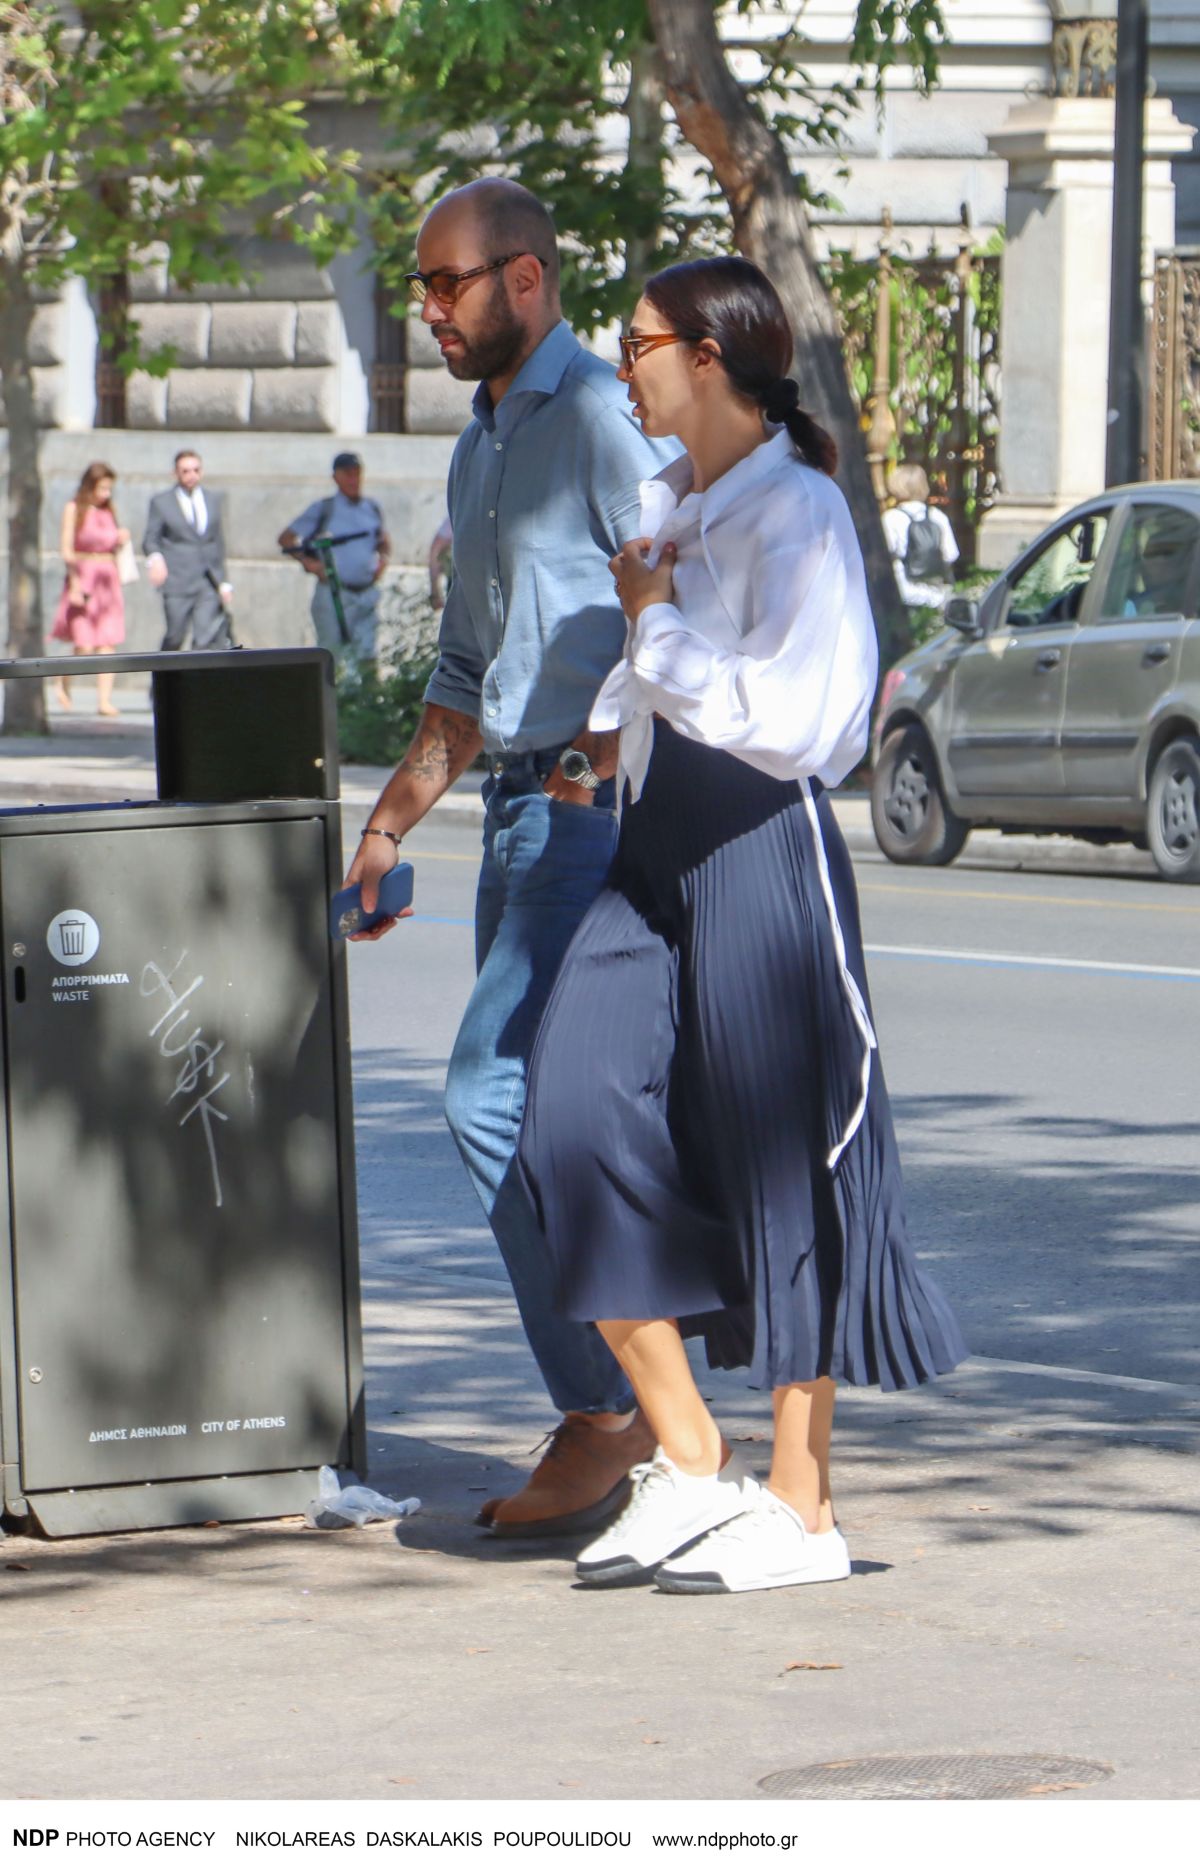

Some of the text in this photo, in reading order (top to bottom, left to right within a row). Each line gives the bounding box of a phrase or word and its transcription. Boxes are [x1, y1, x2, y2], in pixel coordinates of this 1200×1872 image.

[52, 973, 130, 987] ΑΠΟΡΡΙΜΜΑΤΑ
[52, 991, 90, 1001] WASTE
[129, 1424, 187, 1439] ΑΘΗΝΑΙΩΝ
[201, 1416, 286, 1433] CITY OF ATHENS
